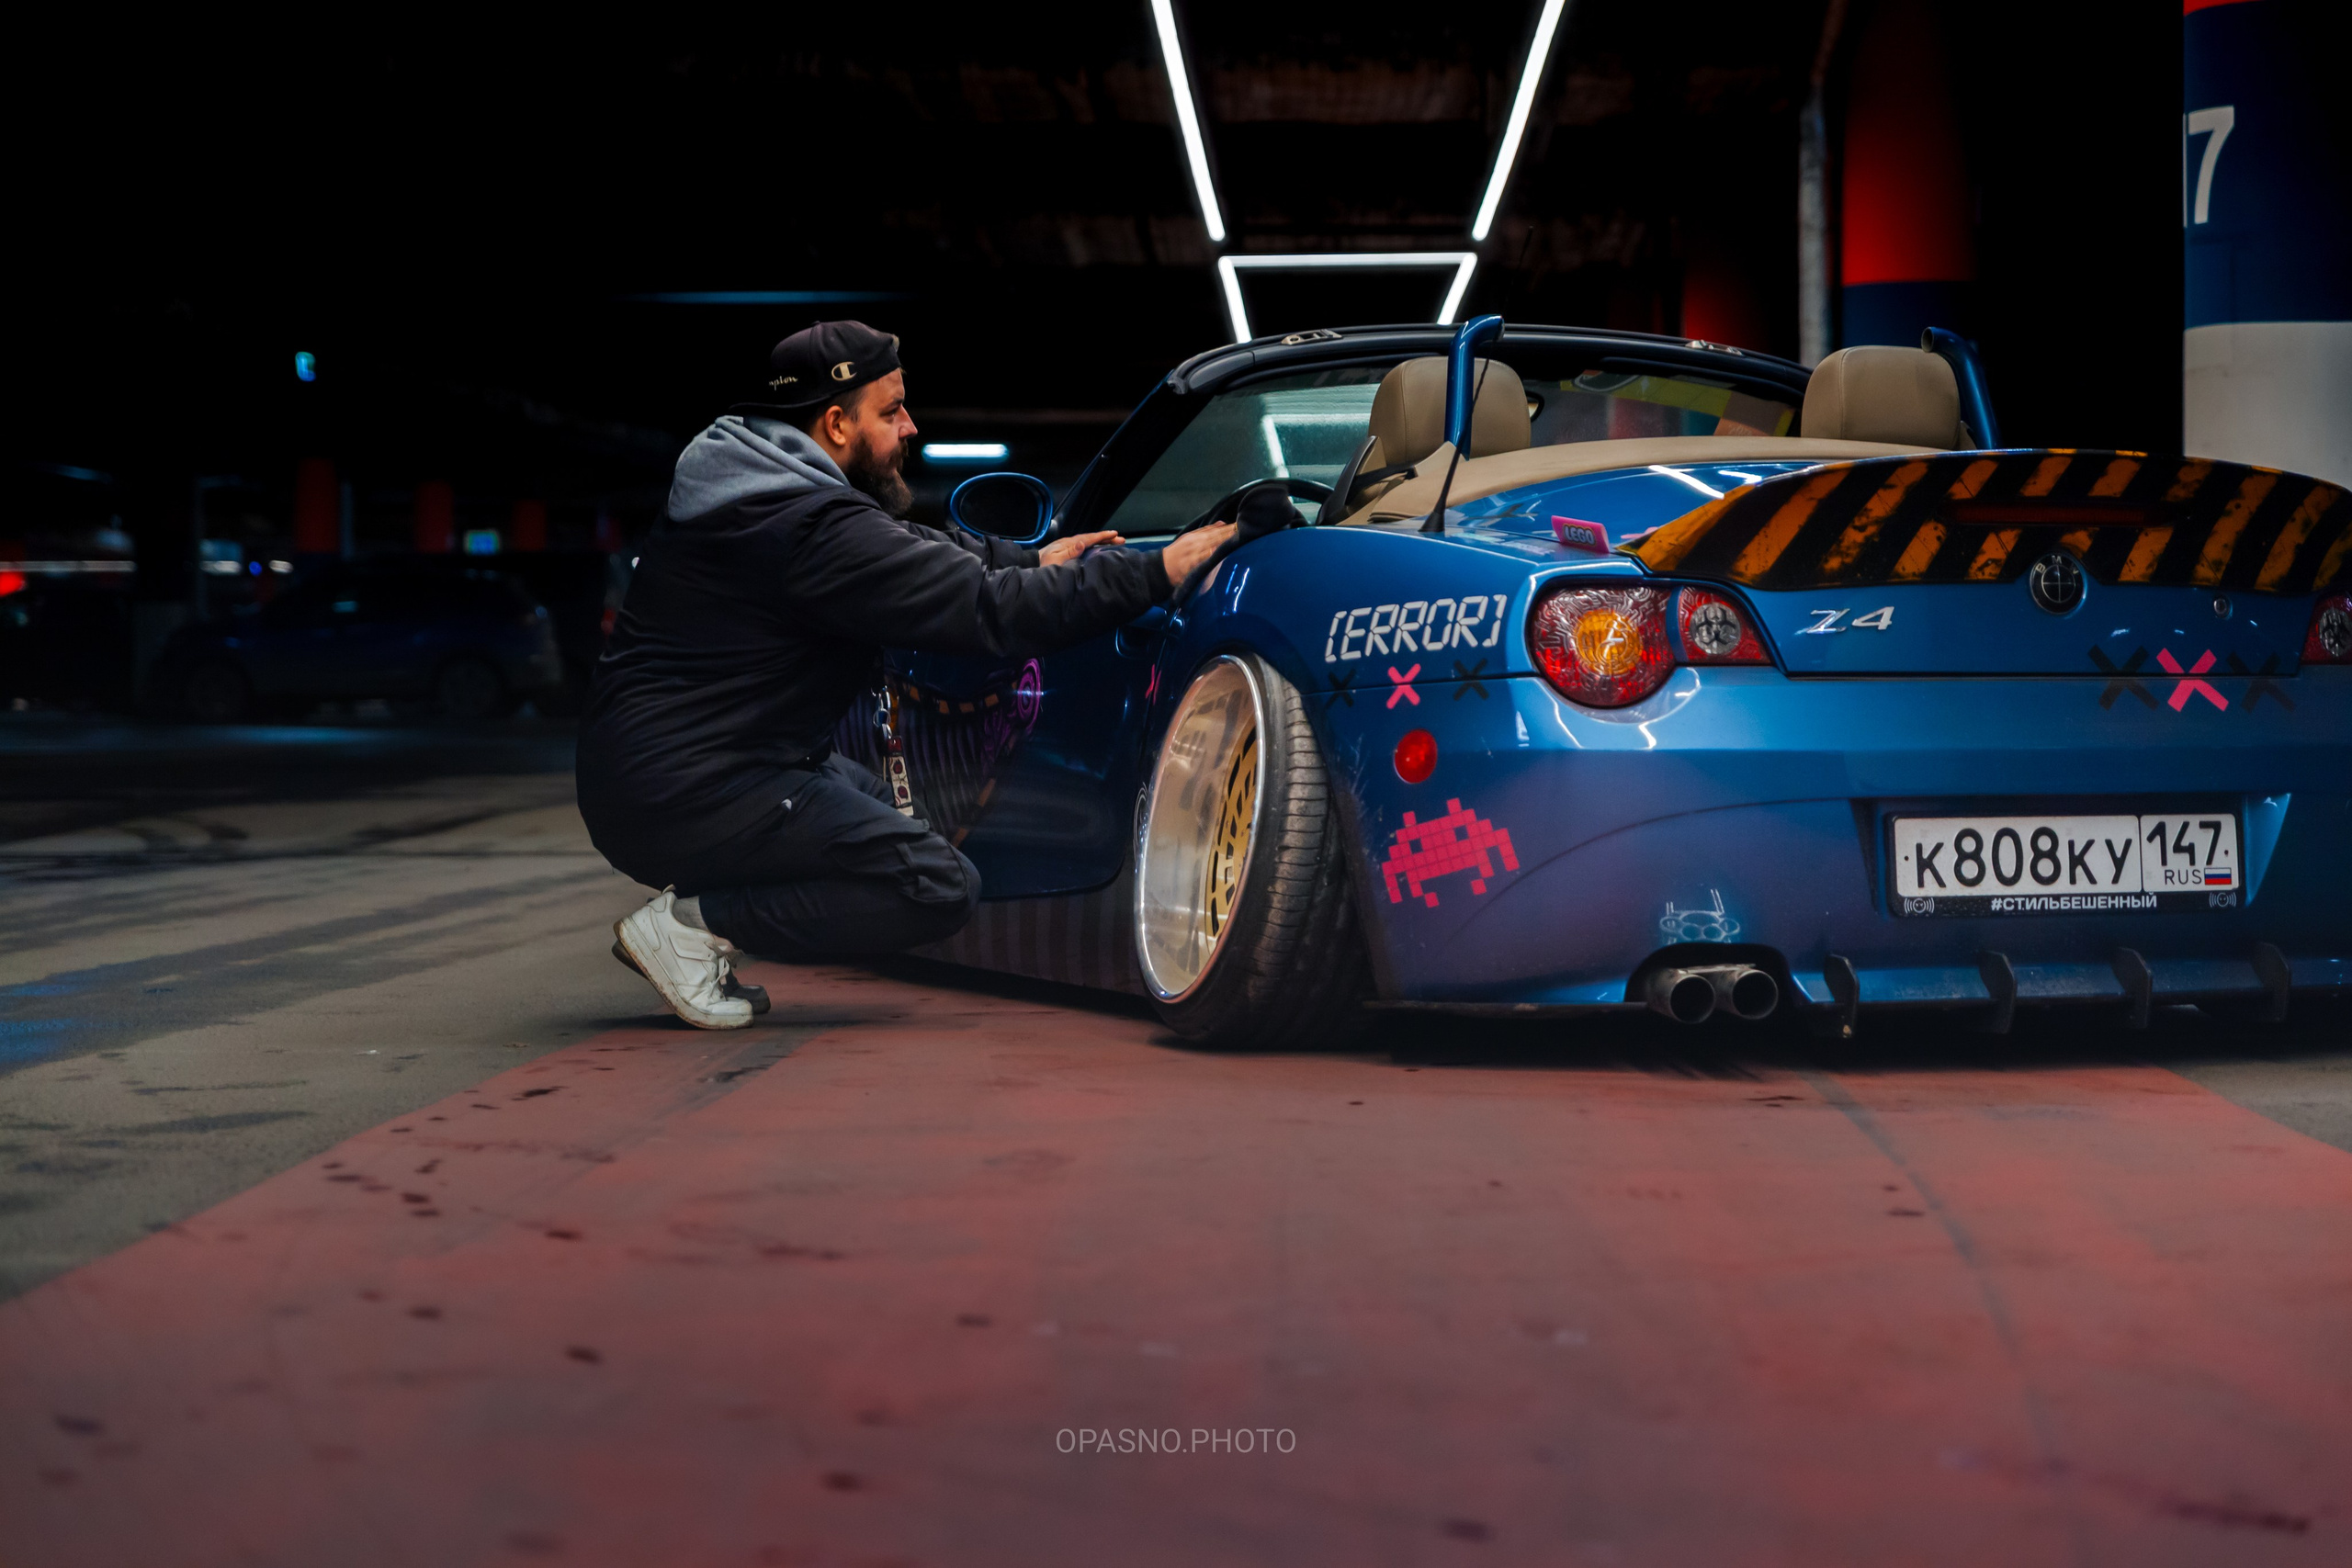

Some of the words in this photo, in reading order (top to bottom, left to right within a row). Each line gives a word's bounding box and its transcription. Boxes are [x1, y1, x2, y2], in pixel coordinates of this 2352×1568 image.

[2183, 105, 2234, 228] 7
[1564, 524, 1596, 546] LEGO
[1325, 594, 1506, 663] [ERROR]
[1806, 605, 1894, 634] Z4
[2146, 820, 2222, 866] 147
[2164, 869, 2202, 885] RUS
